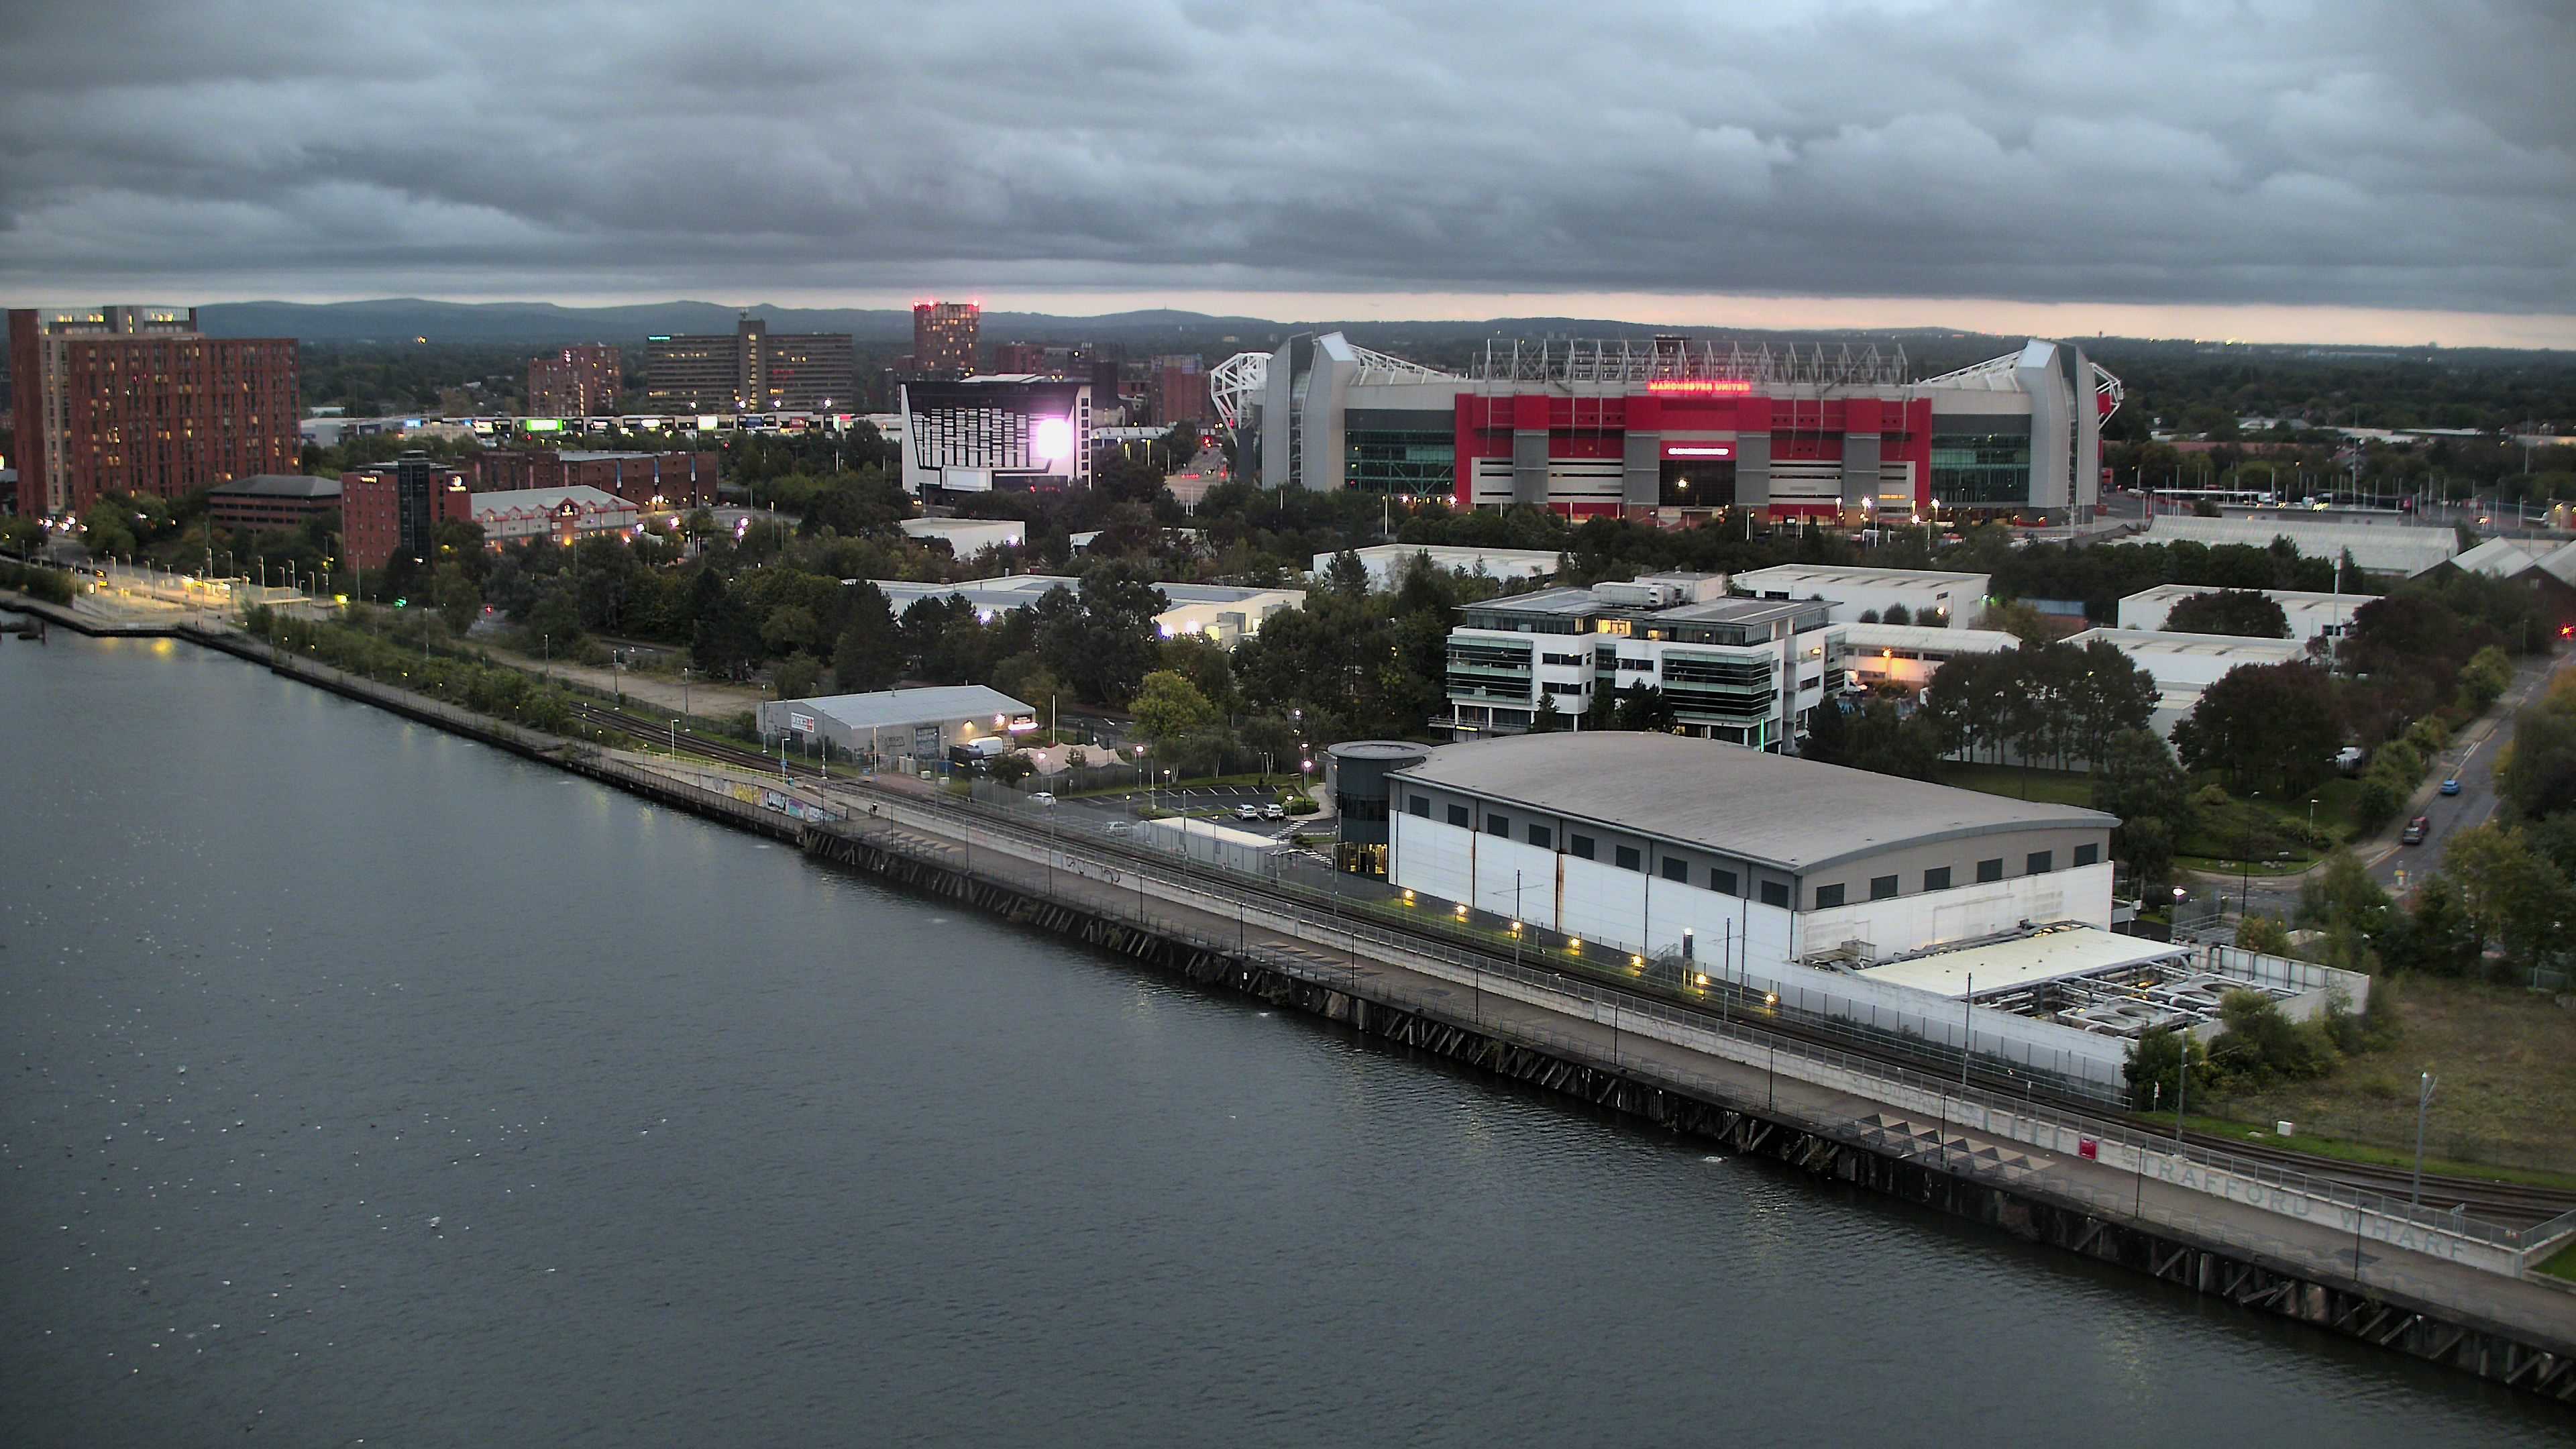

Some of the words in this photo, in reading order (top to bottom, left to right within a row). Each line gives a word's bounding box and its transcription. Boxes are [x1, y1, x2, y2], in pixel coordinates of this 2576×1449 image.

[1650, 382, 1712, 391] MANCHESTER
[1715, 382, 1750, 392] UNITED
[2139, 1152, 2312, 1217] TRAFFORD
[2339, 1209, 2465, 1258] WHARF
